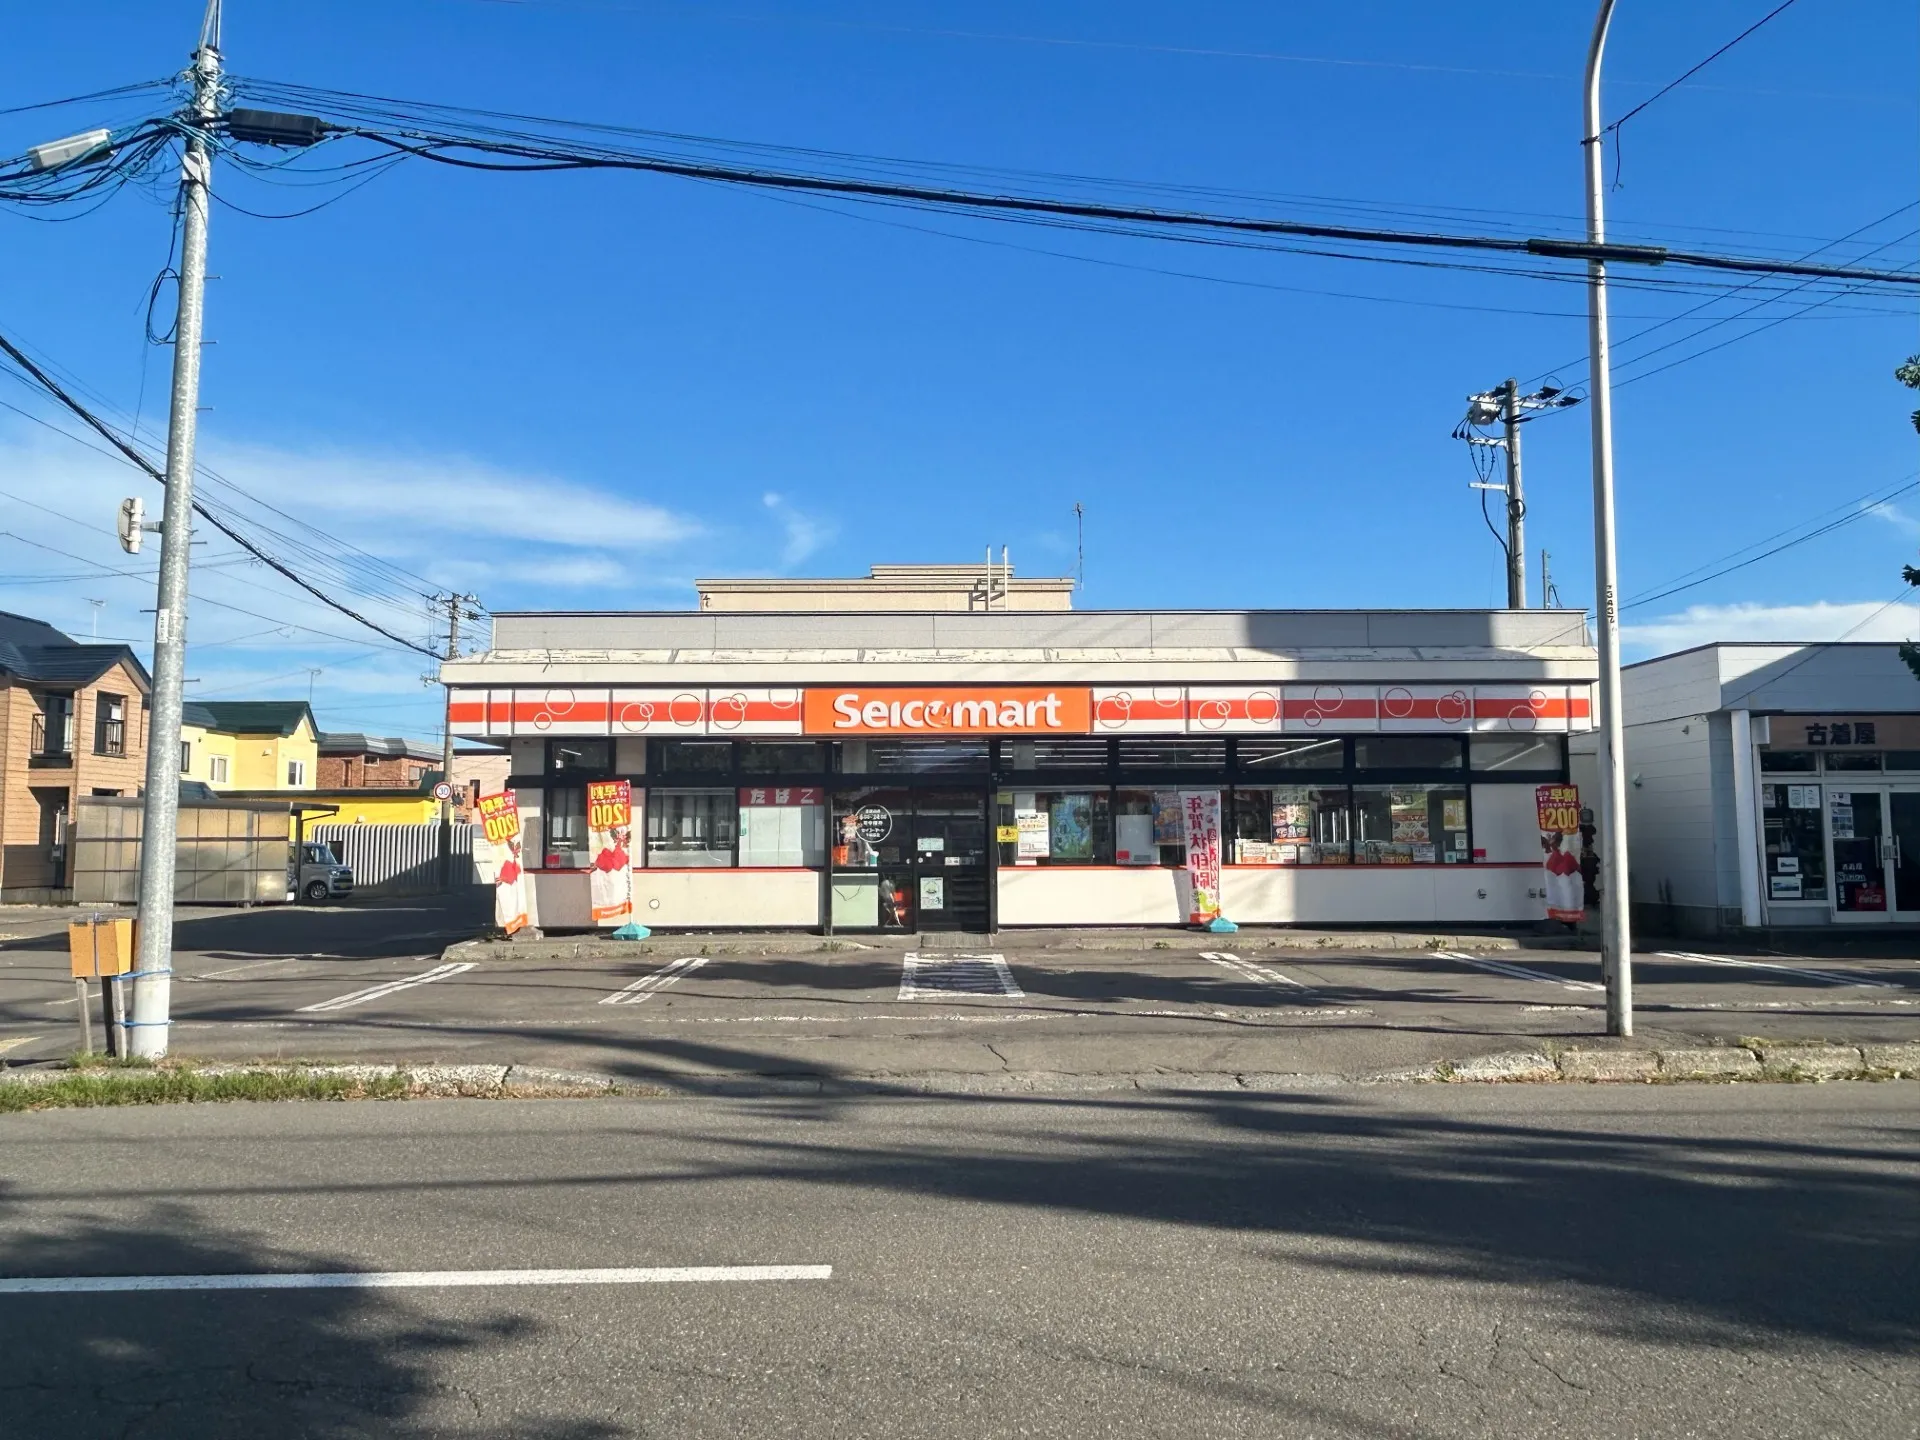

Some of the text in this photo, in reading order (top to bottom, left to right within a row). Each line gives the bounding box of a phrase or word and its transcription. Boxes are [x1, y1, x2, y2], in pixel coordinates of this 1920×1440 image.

[833, 692, 1062, 728] Seicomart
[1804, 722, 1876, 745] 古着屋
[438, 787, 449, 796] 30
[1545, 807, 1578, 829] 200
